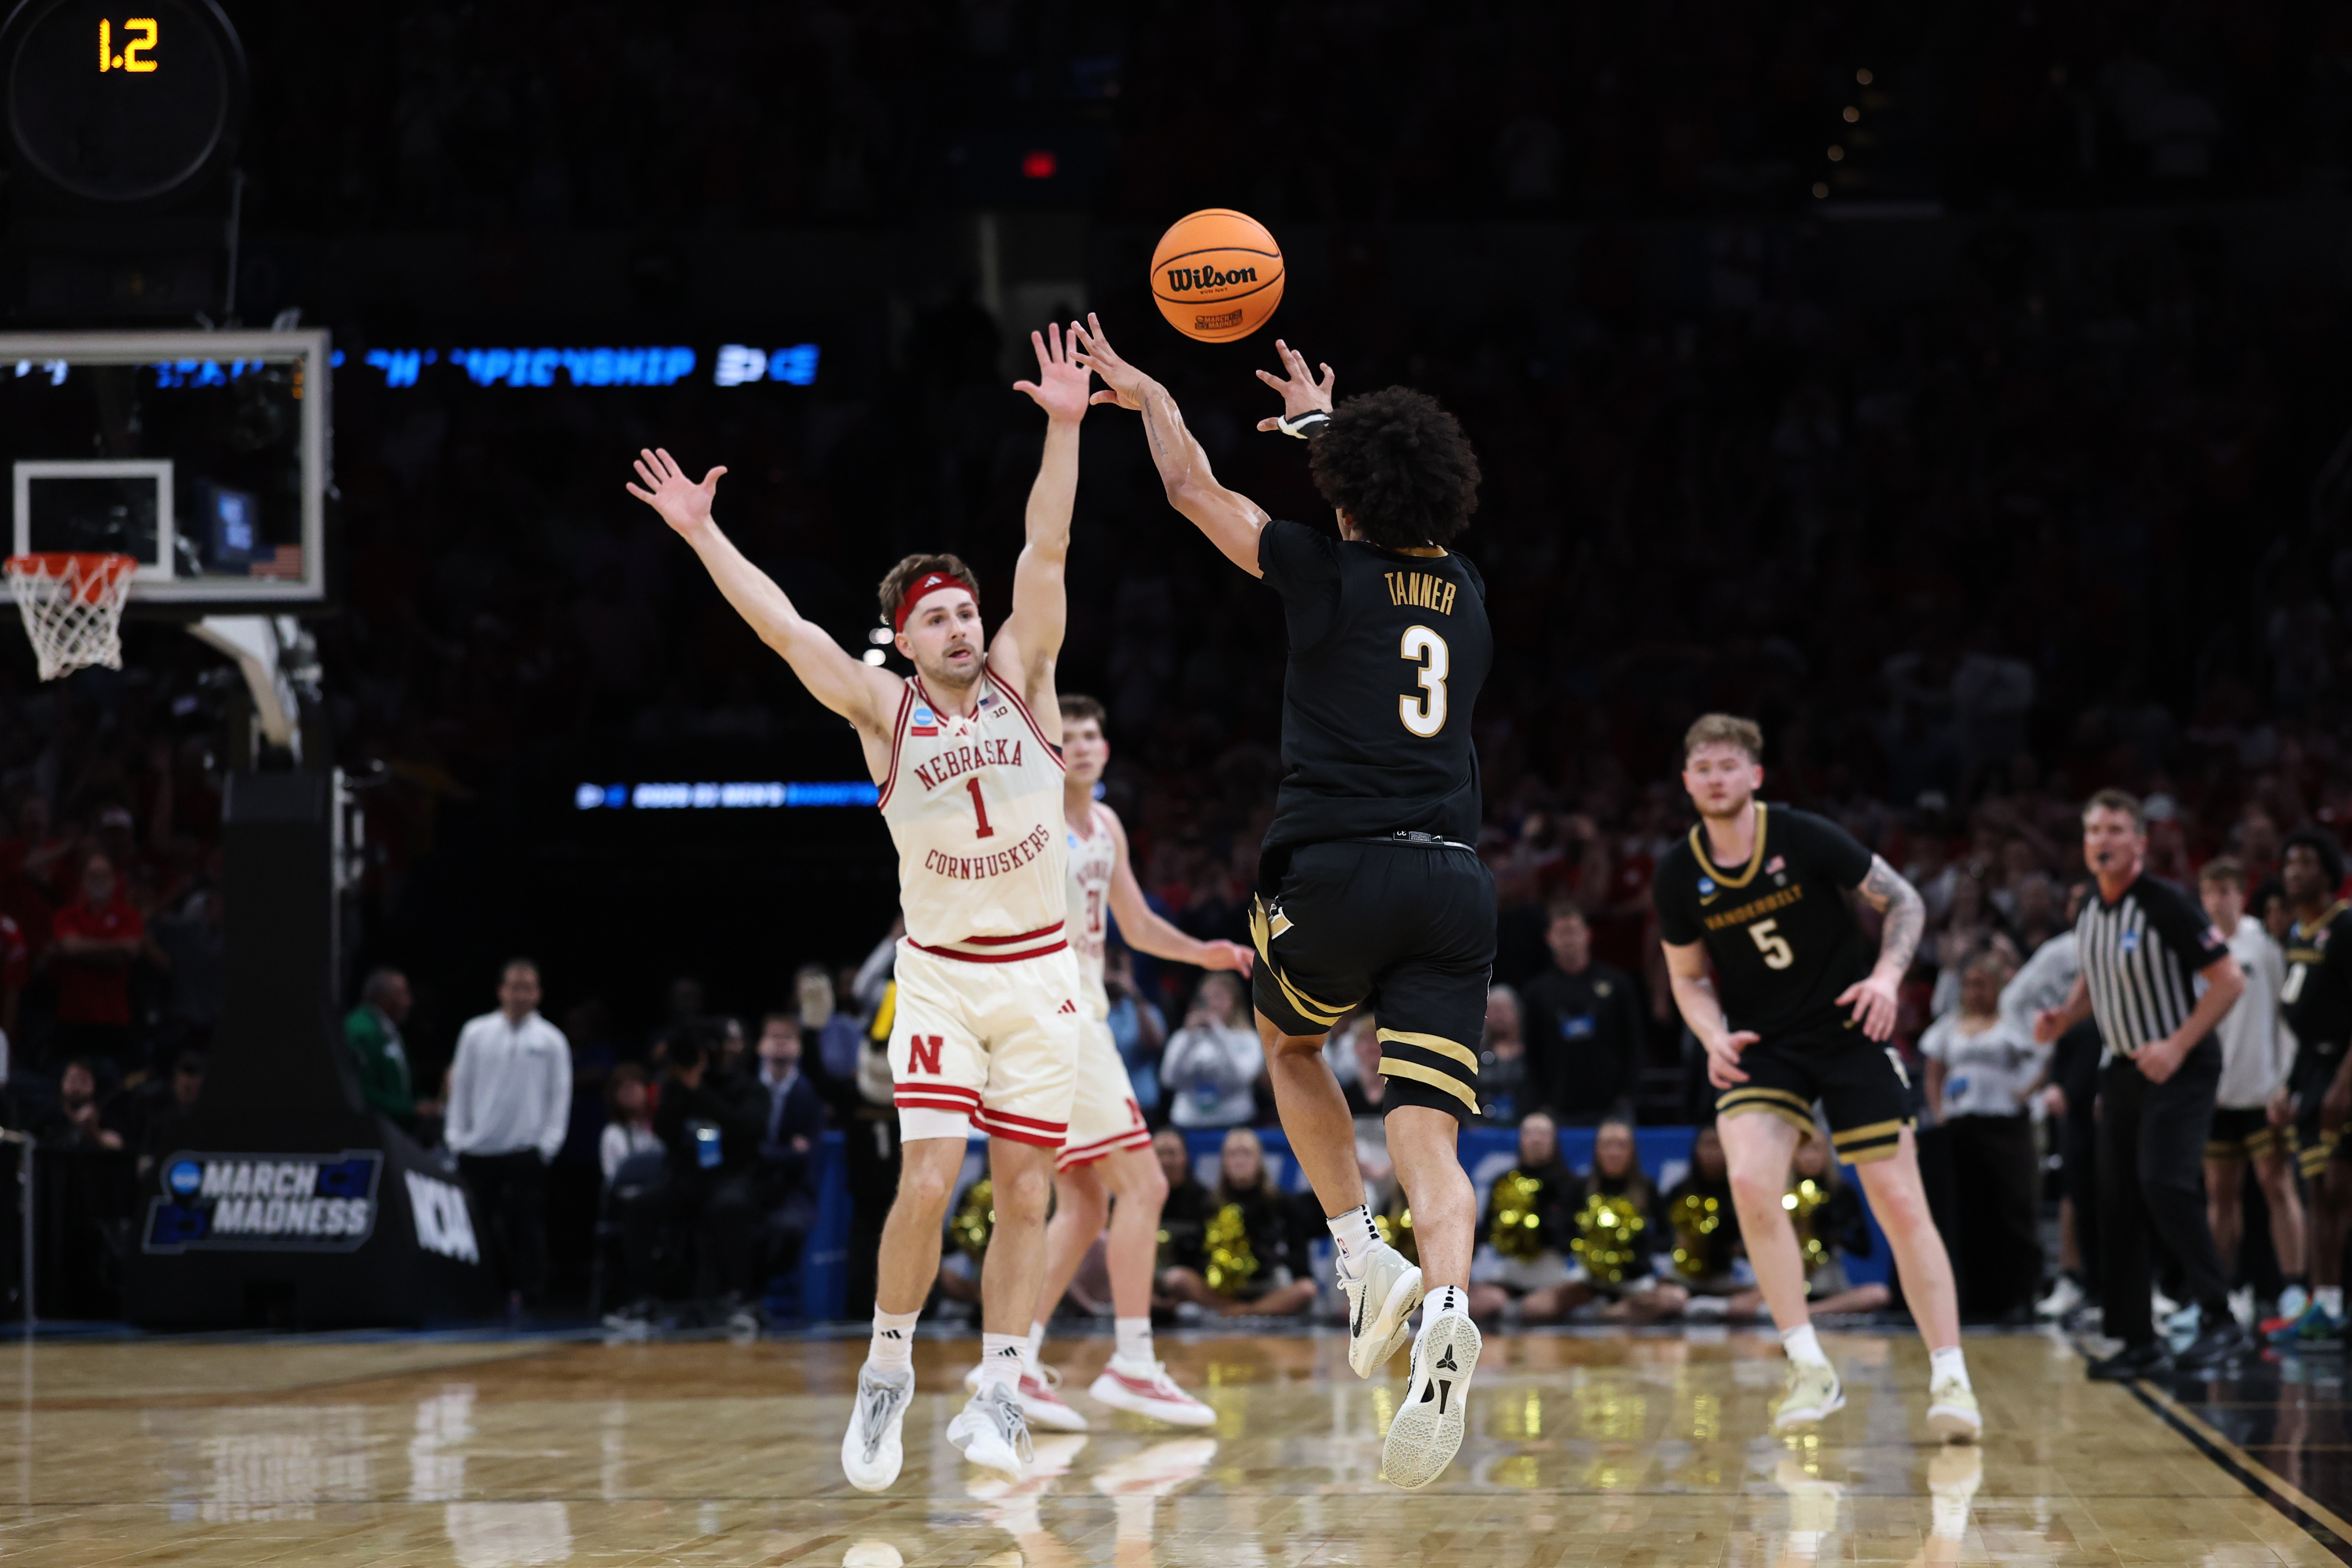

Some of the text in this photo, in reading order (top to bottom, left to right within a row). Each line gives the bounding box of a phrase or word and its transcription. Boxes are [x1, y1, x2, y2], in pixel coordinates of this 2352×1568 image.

[99, 18, 158, 72] 1.2
[1168, 265, 1257, 292] Wilson
[1384, 571, 1456, 616] TANNER
[1399, 624, 1449, 738] 3
[914, 739, 1022, 792] NEBRASKA
[966, 777, 994, 839] 1
[925, 824, 1050, 880] CORNHUSKERS
[1748, 917, 1794, 970] 5
[907, 1034, 944, 1075] N
[201, 1160, 319, 1198] MARCH
[212, 1196, 368, 1236] MADNESS
